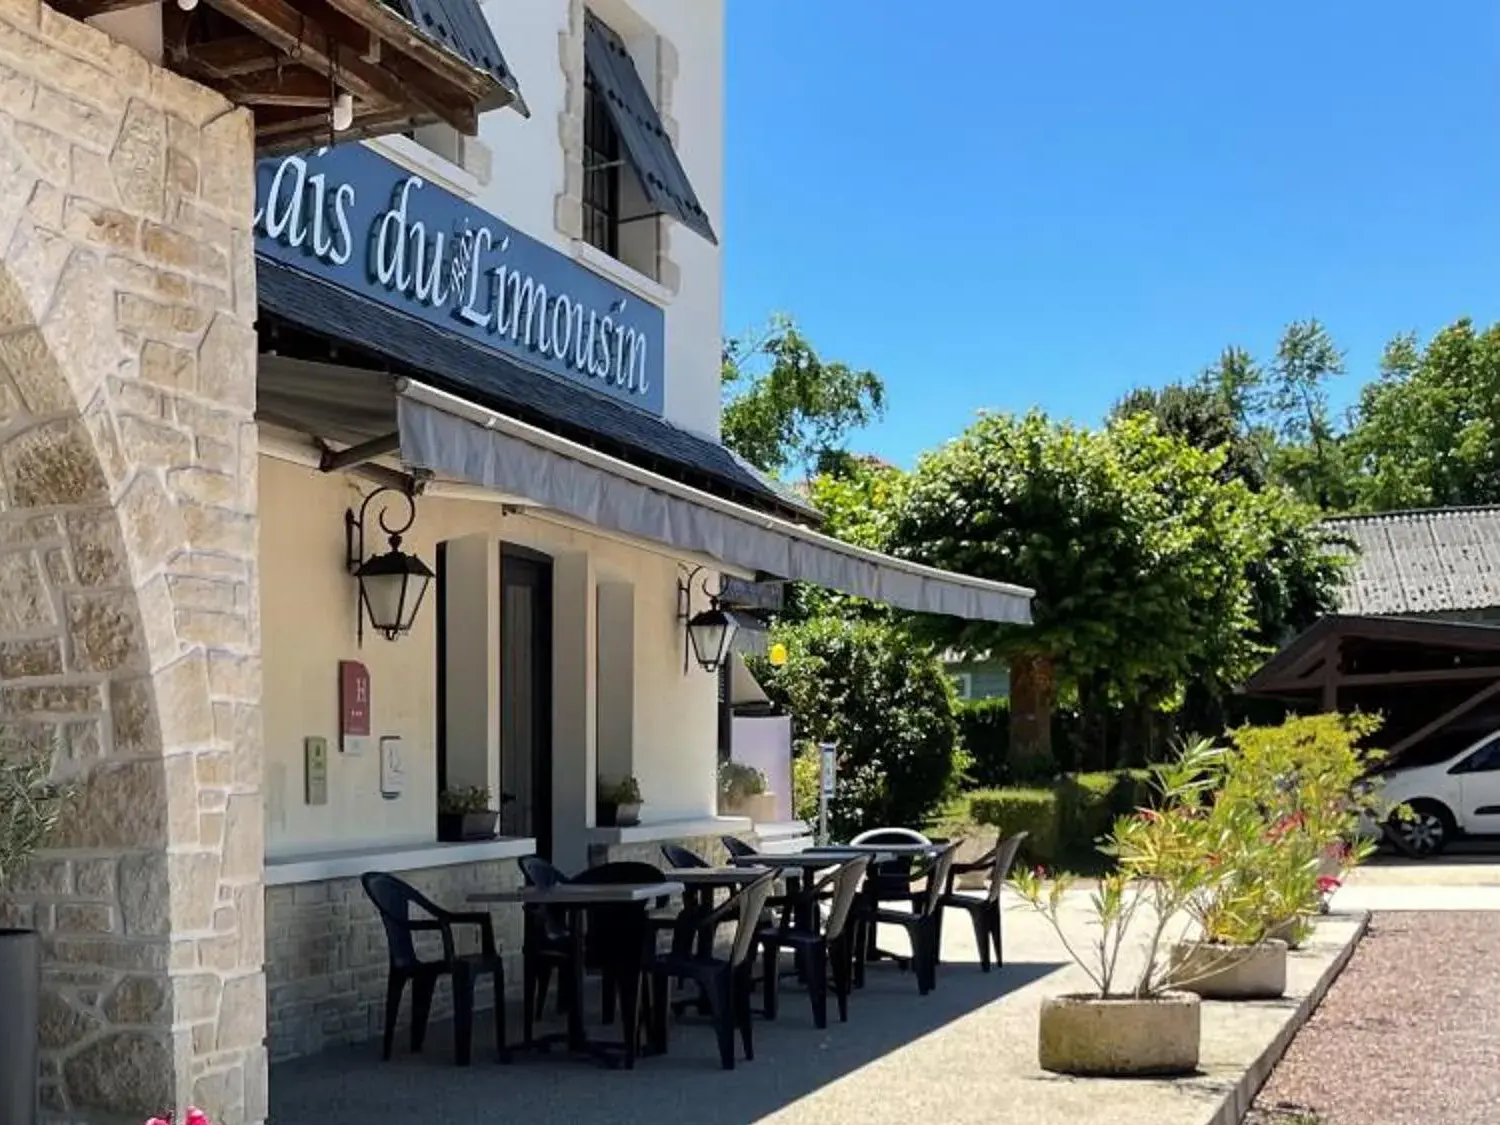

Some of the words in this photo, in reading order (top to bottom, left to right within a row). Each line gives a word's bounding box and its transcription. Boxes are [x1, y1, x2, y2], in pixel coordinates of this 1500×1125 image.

[377, 175, 449, 307] du
[460, 226, 650, 395] Limousin
[356, 677, 367, 703] H
